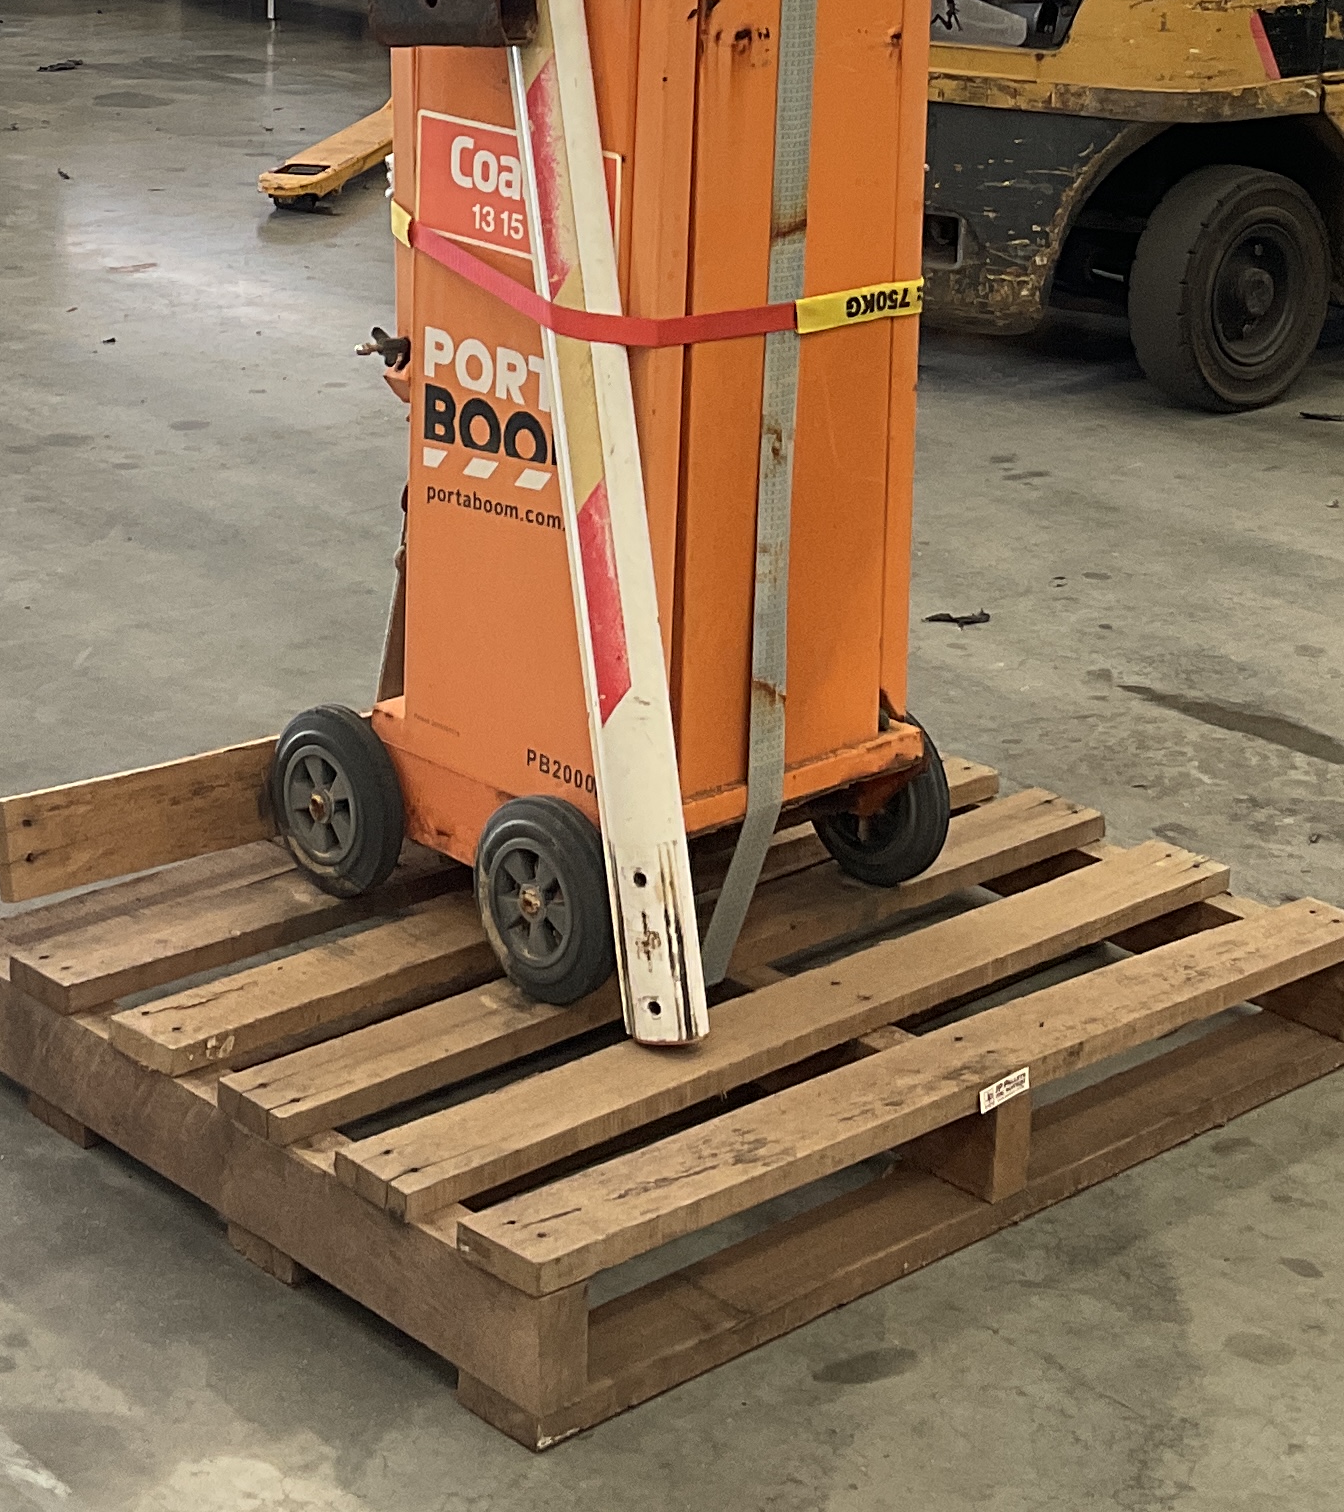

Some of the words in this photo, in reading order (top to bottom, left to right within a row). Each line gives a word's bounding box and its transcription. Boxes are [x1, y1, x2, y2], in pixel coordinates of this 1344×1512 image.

[450, 135, 525, 201] Coa
[471, 203, 496, 233] 13
[500, 210, 525, 240] 15
[846, 287, 911, 318] 750KG
[424, 325, 552, 413] PORT
[424, 382, 557, 466] BOO
[426, 485, 566, 532] portaboom.com.
